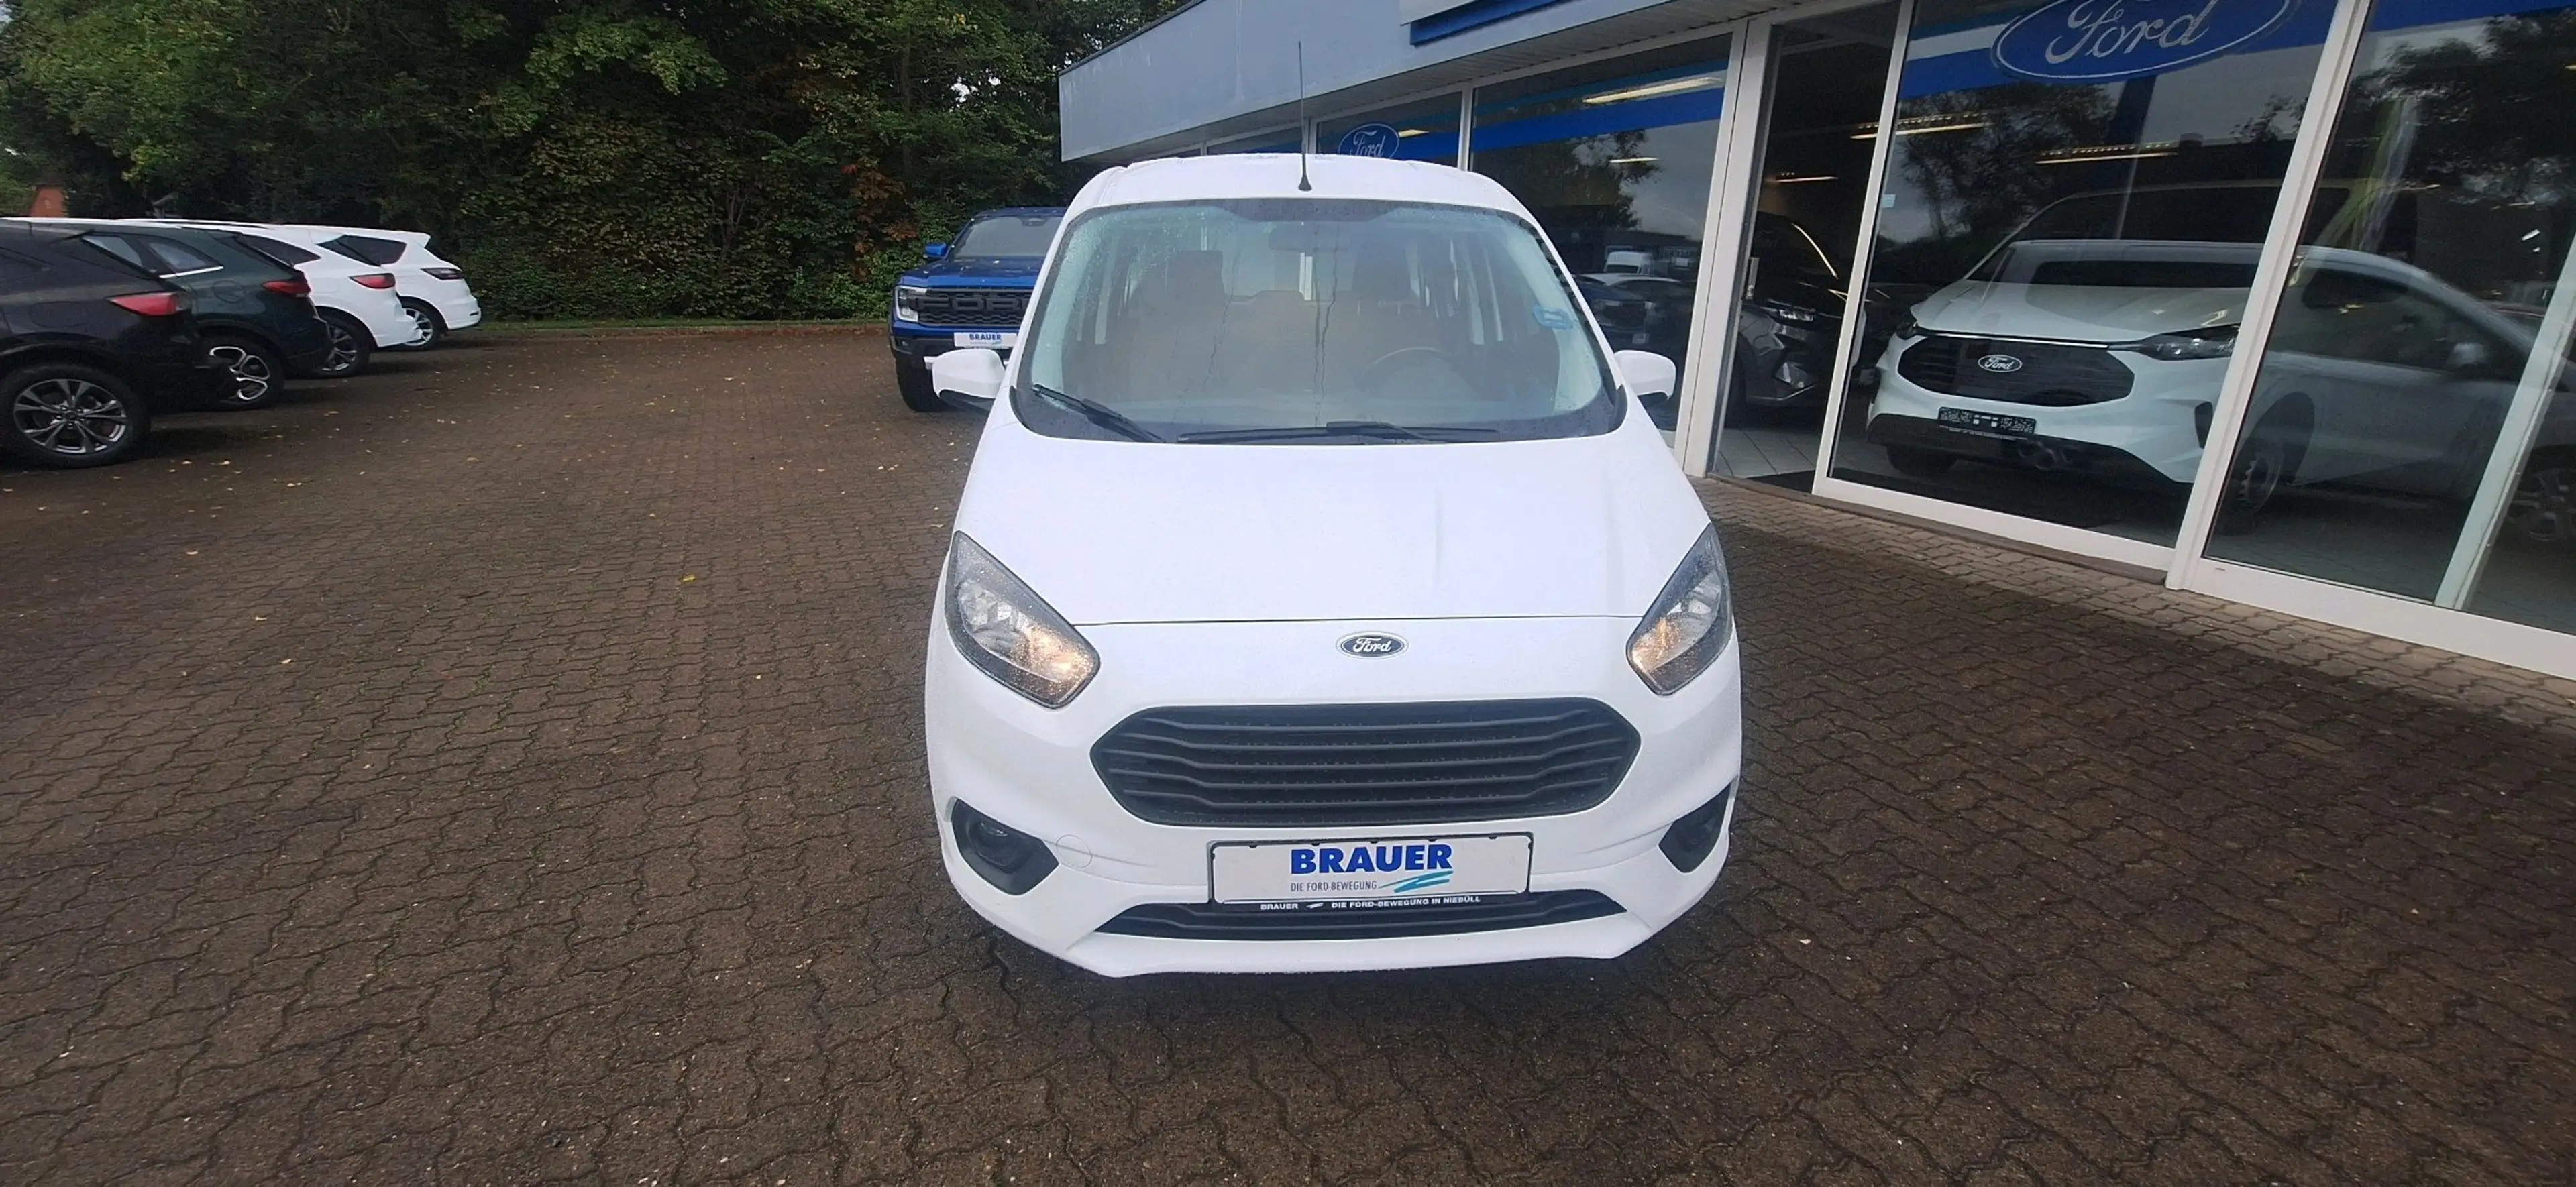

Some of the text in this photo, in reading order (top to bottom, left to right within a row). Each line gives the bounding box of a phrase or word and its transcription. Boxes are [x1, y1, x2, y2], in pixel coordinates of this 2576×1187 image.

[2045, 0, 2214, 64] Ford
[1349, 130, 1387, 158] Ford
[1984, 357, 2015, 370] Ford
[1352, 637, 1392, 652] Ford
[1291, 844, 1452, 874] BRAUER
[1291, 880, 1377, 891] DIE FORD-BEWEGUNG
[1260, 903, 1299, 911] BRAUER
[1349, 899, 1430, 908] FORD-BEWEGUNG
[1443, 895, 1481, 903] NIEBÜLL
